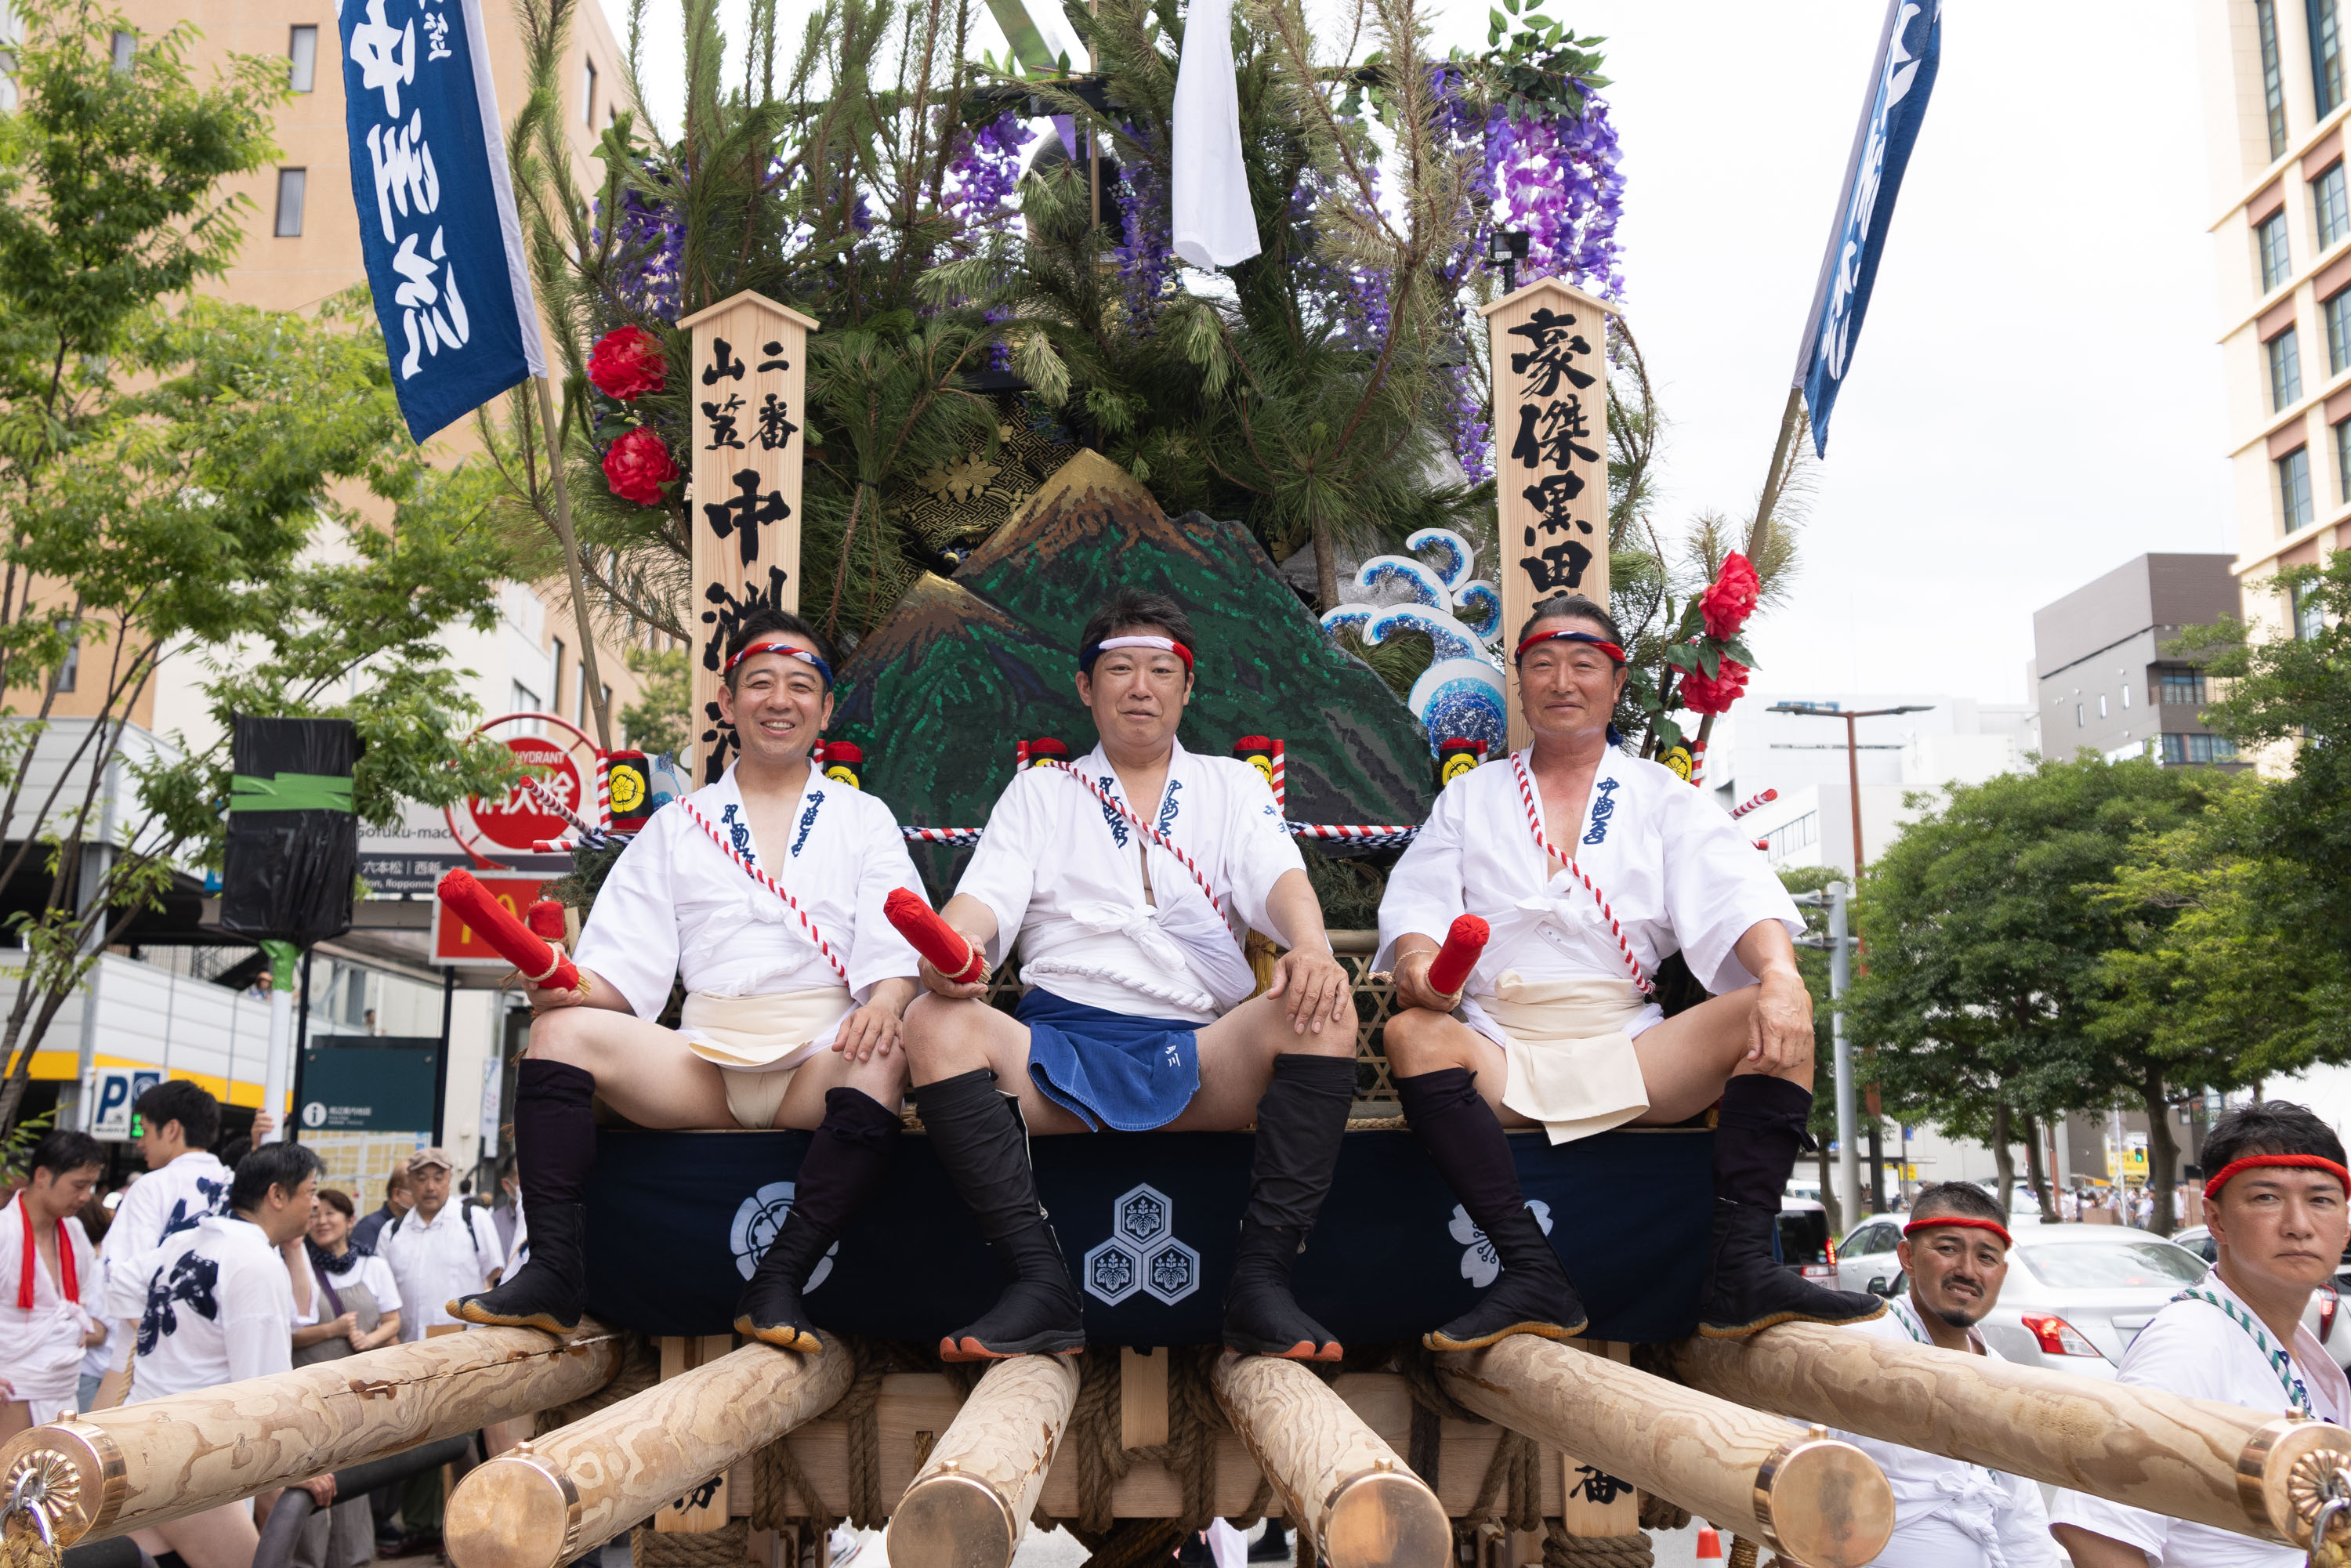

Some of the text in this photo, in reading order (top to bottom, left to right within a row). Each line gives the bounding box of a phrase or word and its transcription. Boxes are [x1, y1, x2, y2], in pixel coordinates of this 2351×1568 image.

[701, 337, 746, 451] 山笠
[748, 340, 799, 451] 二番
[1507, 307, 1601, 614] 豪傑黒田
[701, 468, 792, 784] 中洲
[96, 1076, 128, 1124] P
